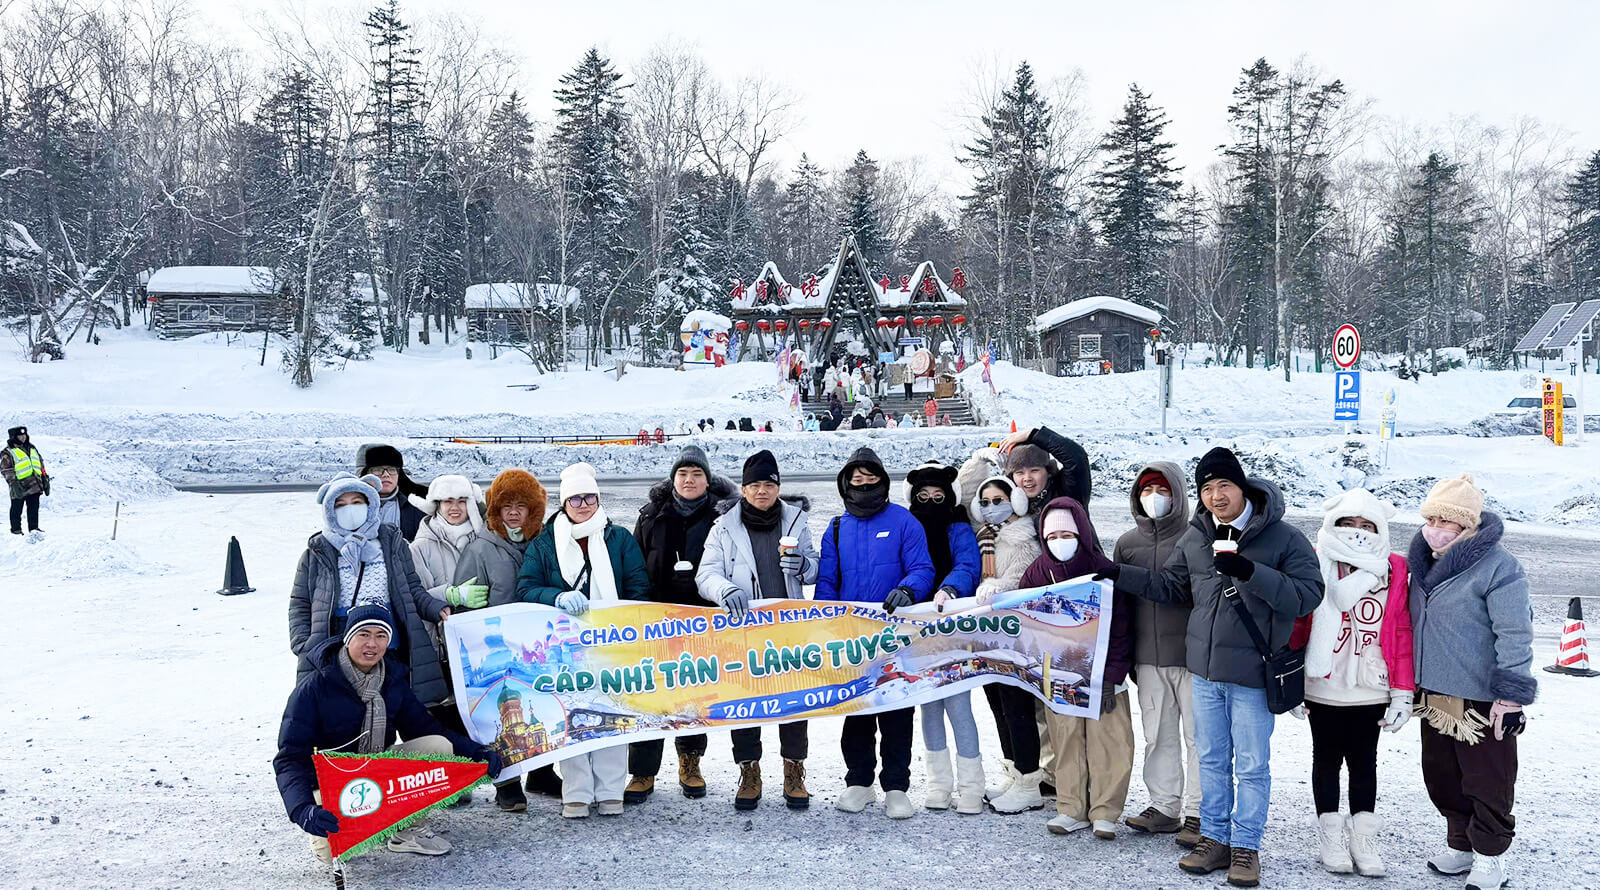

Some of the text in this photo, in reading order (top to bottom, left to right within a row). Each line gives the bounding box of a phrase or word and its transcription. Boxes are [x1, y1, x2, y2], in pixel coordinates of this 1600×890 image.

[1338, 336, 1354, 356] 60
[1338, 374, 1354, 400] P
[579, 626, 637, 646] CHÀO
[644, 615, 708, 641] MỪNG
[780, 604, 848, 622] KHÁCH
[534, 665, 594, 693] CÁP
[600, 657, 655, 694] NHĨ
[659, 652, 718, 688] TÂN
[749, 640, 822, 677] LÀNG
[826, 625, 911, 667] TUYẾT
[386, 767, 449, 795] J TRAVEL
